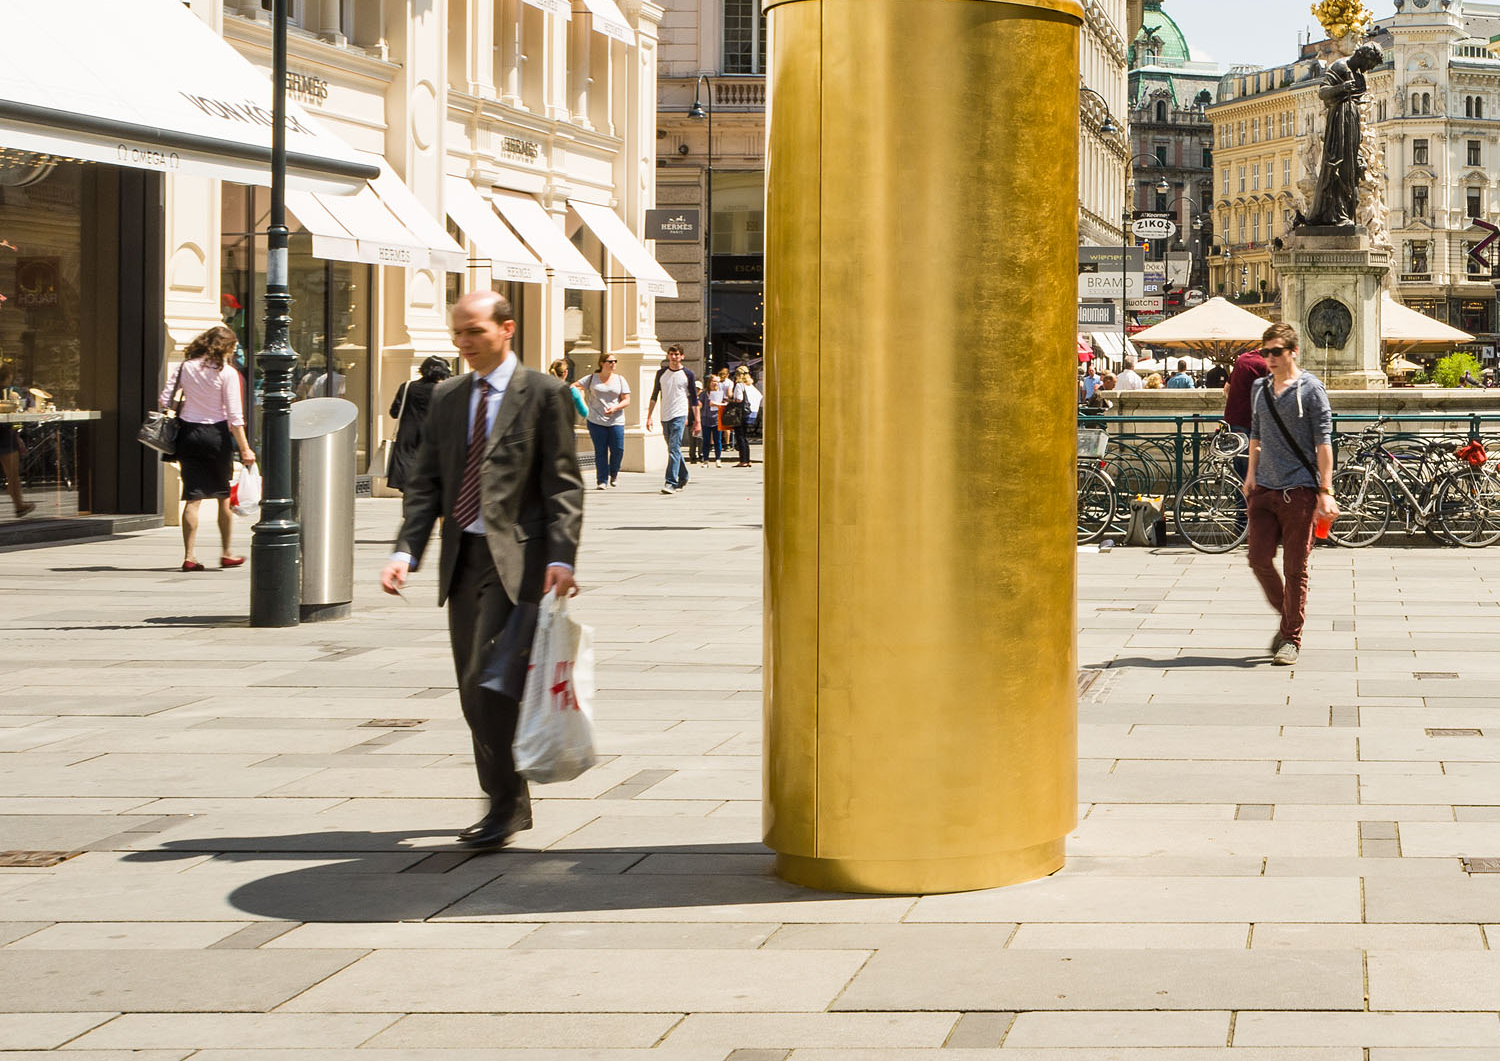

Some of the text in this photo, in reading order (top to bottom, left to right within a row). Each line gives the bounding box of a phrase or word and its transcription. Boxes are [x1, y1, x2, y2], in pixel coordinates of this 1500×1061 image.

[284, 70, 329, 100] ERMÈS
[131, 148, 166, 166] OMEGA
[1137, 219, 1172, 230] ZIKOS
[735, 264, 762, 272] ESCAD
[1088, 277, 1134, 289] BRAMO
